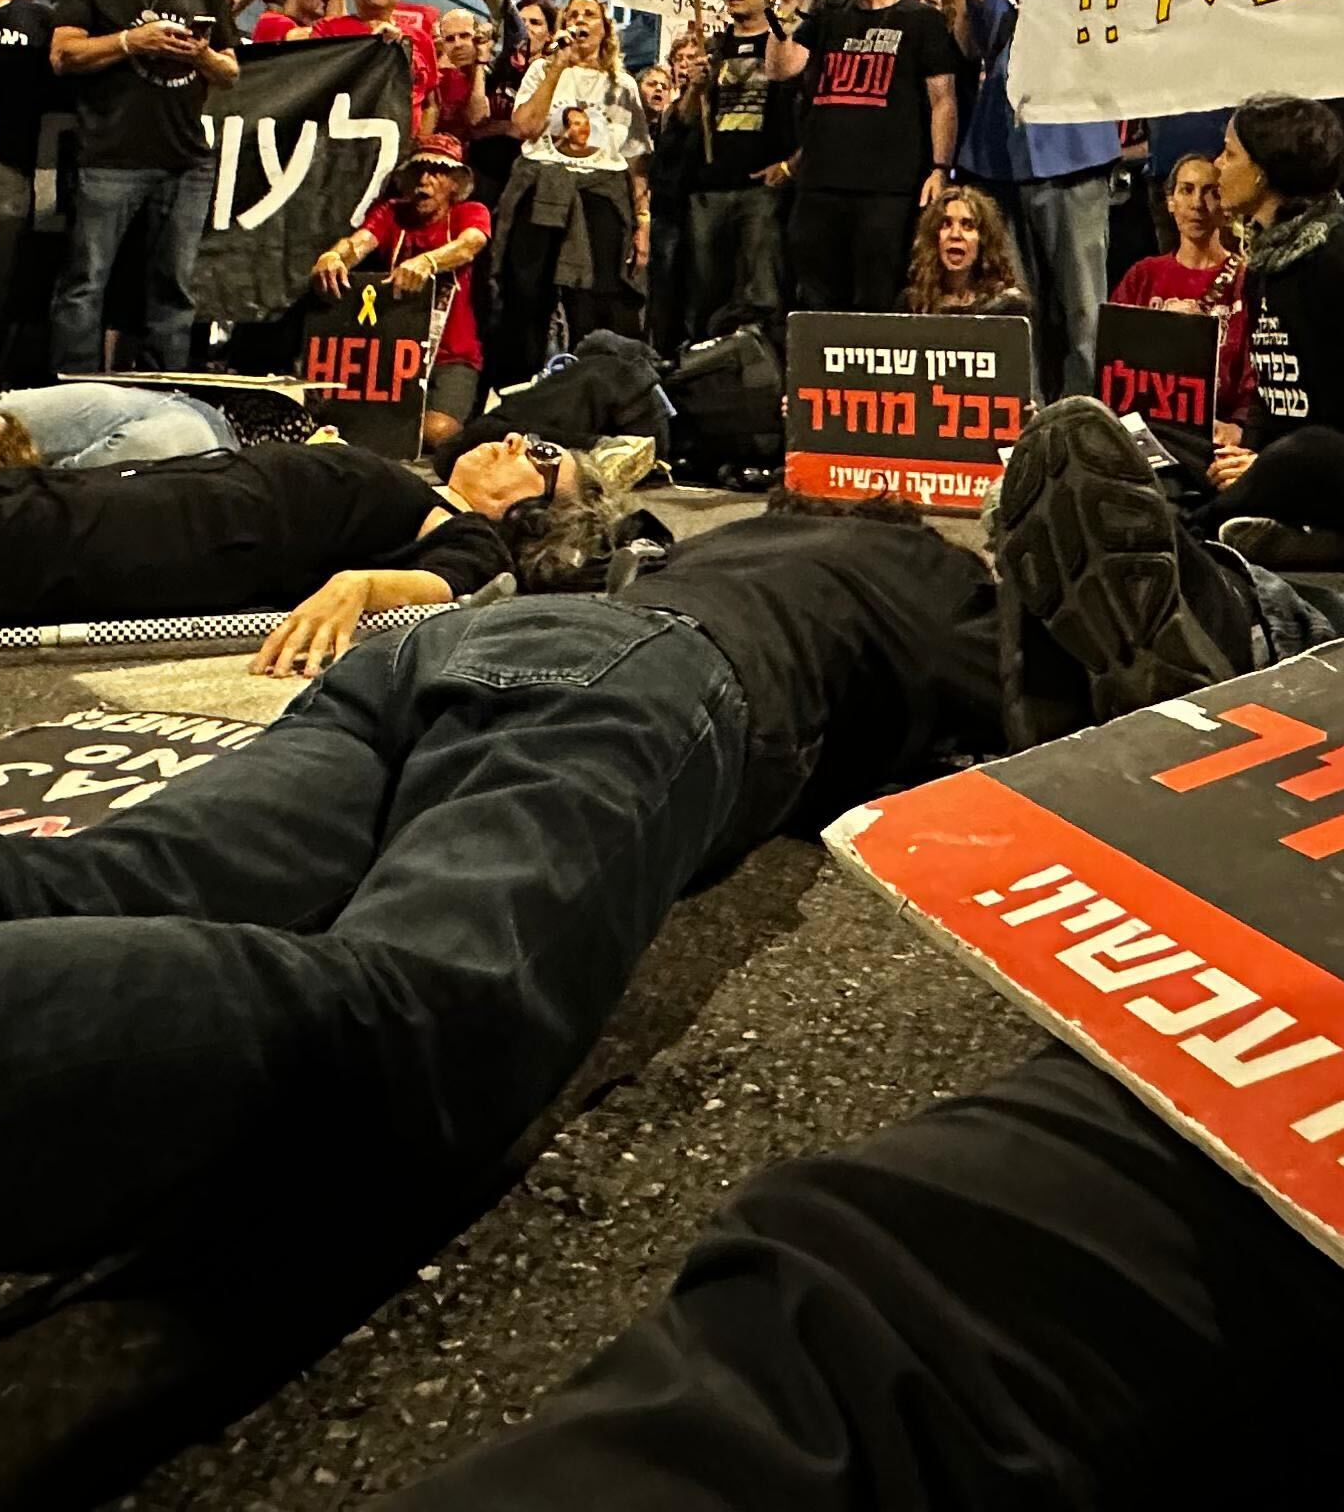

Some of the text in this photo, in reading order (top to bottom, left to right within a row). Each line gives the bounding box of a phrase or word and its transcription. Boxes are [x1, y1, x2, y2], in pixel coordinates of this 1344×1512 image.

[306, 334, 421, 403] HELP
[823, 346, 997, 381] פדיון שבויים
[1102, 359, 1206, 425] הצילו
[797, 383, 1024, 441] בכל מחיר
[829, 464, 901, 493] עכשיו!
[972, 864, 1344, 1088] עכשיו!
